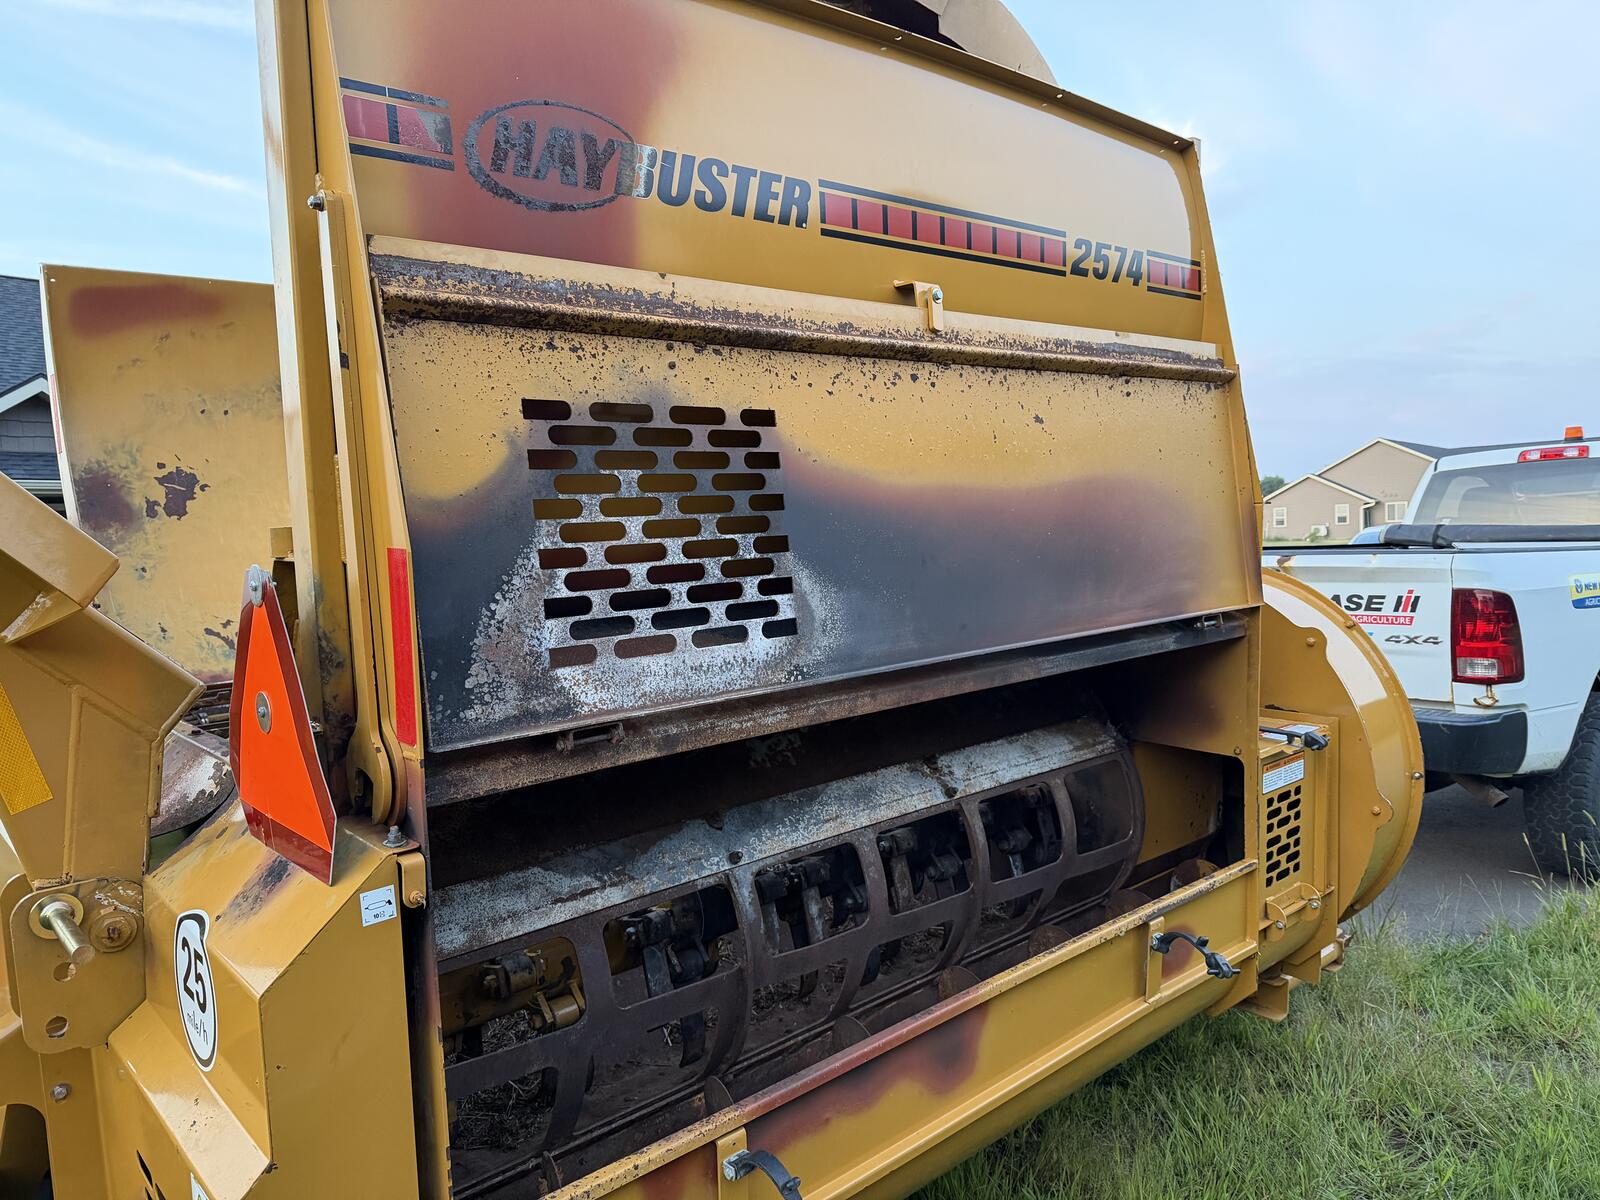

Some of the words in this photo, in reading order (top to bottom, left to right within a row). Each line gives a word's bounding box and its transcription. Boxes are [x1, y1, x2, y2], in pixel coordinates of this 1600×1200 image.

[489, 114, 813, 230] HAYBUSTER
[1069, 237, 1144, 287] 2574
[1330, 593, 1387, 612] ASE
[1351, 615, 1412, 625] AGRICULTURE
[181, 936, 207, 1014] 25
